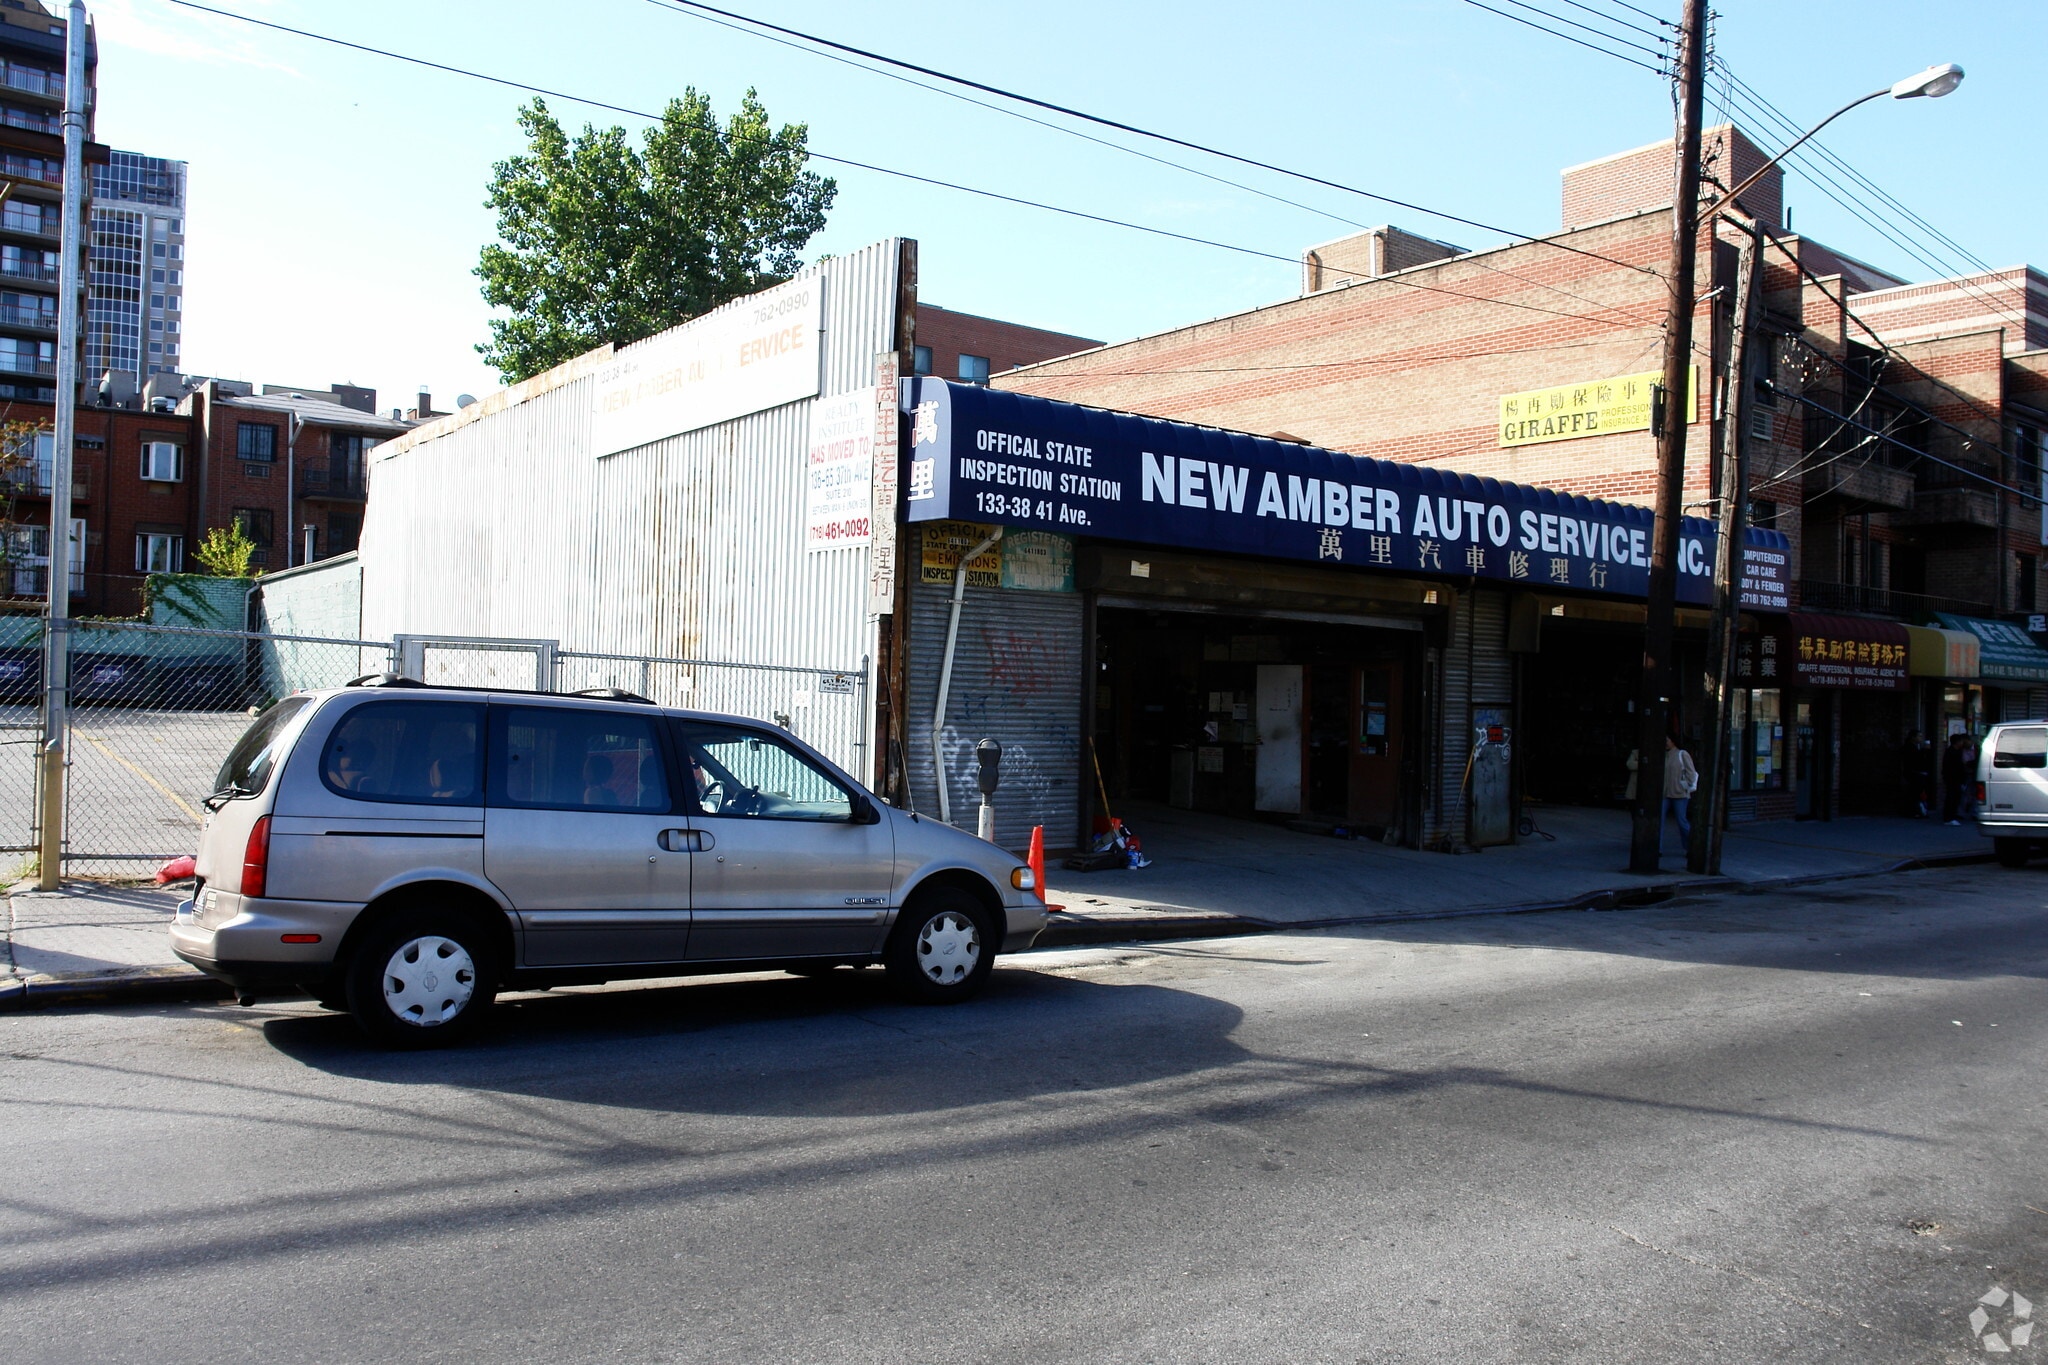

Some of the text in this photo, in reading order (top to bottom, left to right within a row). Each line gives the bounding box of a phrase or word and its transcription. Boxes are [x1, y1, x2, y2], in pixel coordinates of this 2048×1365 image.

[738, 324, 804, 368] ERVICE
[825, 401, 858, 420] REALTY
[818, 417, 865, 440] INSTITUTE
[1504, 403, 1651, 441] GIRAFFE PROFESSION
[1601, 417, 1640, 429] INSURANCE
[810, 445, 825, 465] HAS
[828, 438, 855, 462] MOVED
[907, 400, 939, 500] 萬里
[977, 429, 1093, 468] OFFICAL STATE
[854, 460, 869, 481] AVE
[960, 457, 1121, 502] INSPECTION STATION
[825, 489, 841, 501] SUITE
[976, 492, 1092, 527] 133-38 41 Ave.
[1141, 451, 1250, 514] NEW
[1256, 471, 1402, 534] AMBER
[1412, 494, 1511, 548] AUTO
[1678, 535, 1711, 577] NC.
[825, 517, 869, 540] 461-0092
[929, 524, 990, 542] OFFICIA
[926, 541, 948, 550] STATE
[1006, 531, 1073, 553] REGISTERED
[938, 552, 998, 569] EMIIONS
[1316, 527, 1608, 590] 萬里汽車修理行
[1743, 549, 1785, 565] OMPUTERIZED
[923, 566, 999, 585] INSPECT STATION
[1746, 564, 1777, 578] CAR CARE
[1741, 578, 1785, 593] ODY & FENDER
[1759, 595, 1788, 608] 762-0990
[1760, 635, 1777, 677] 商業
[1797, 663, 1818, 673] GIRAFFE
[1819, 664, 1853, 675] PROFESSIONAL
[844, 897, 886, 906] QUEST
